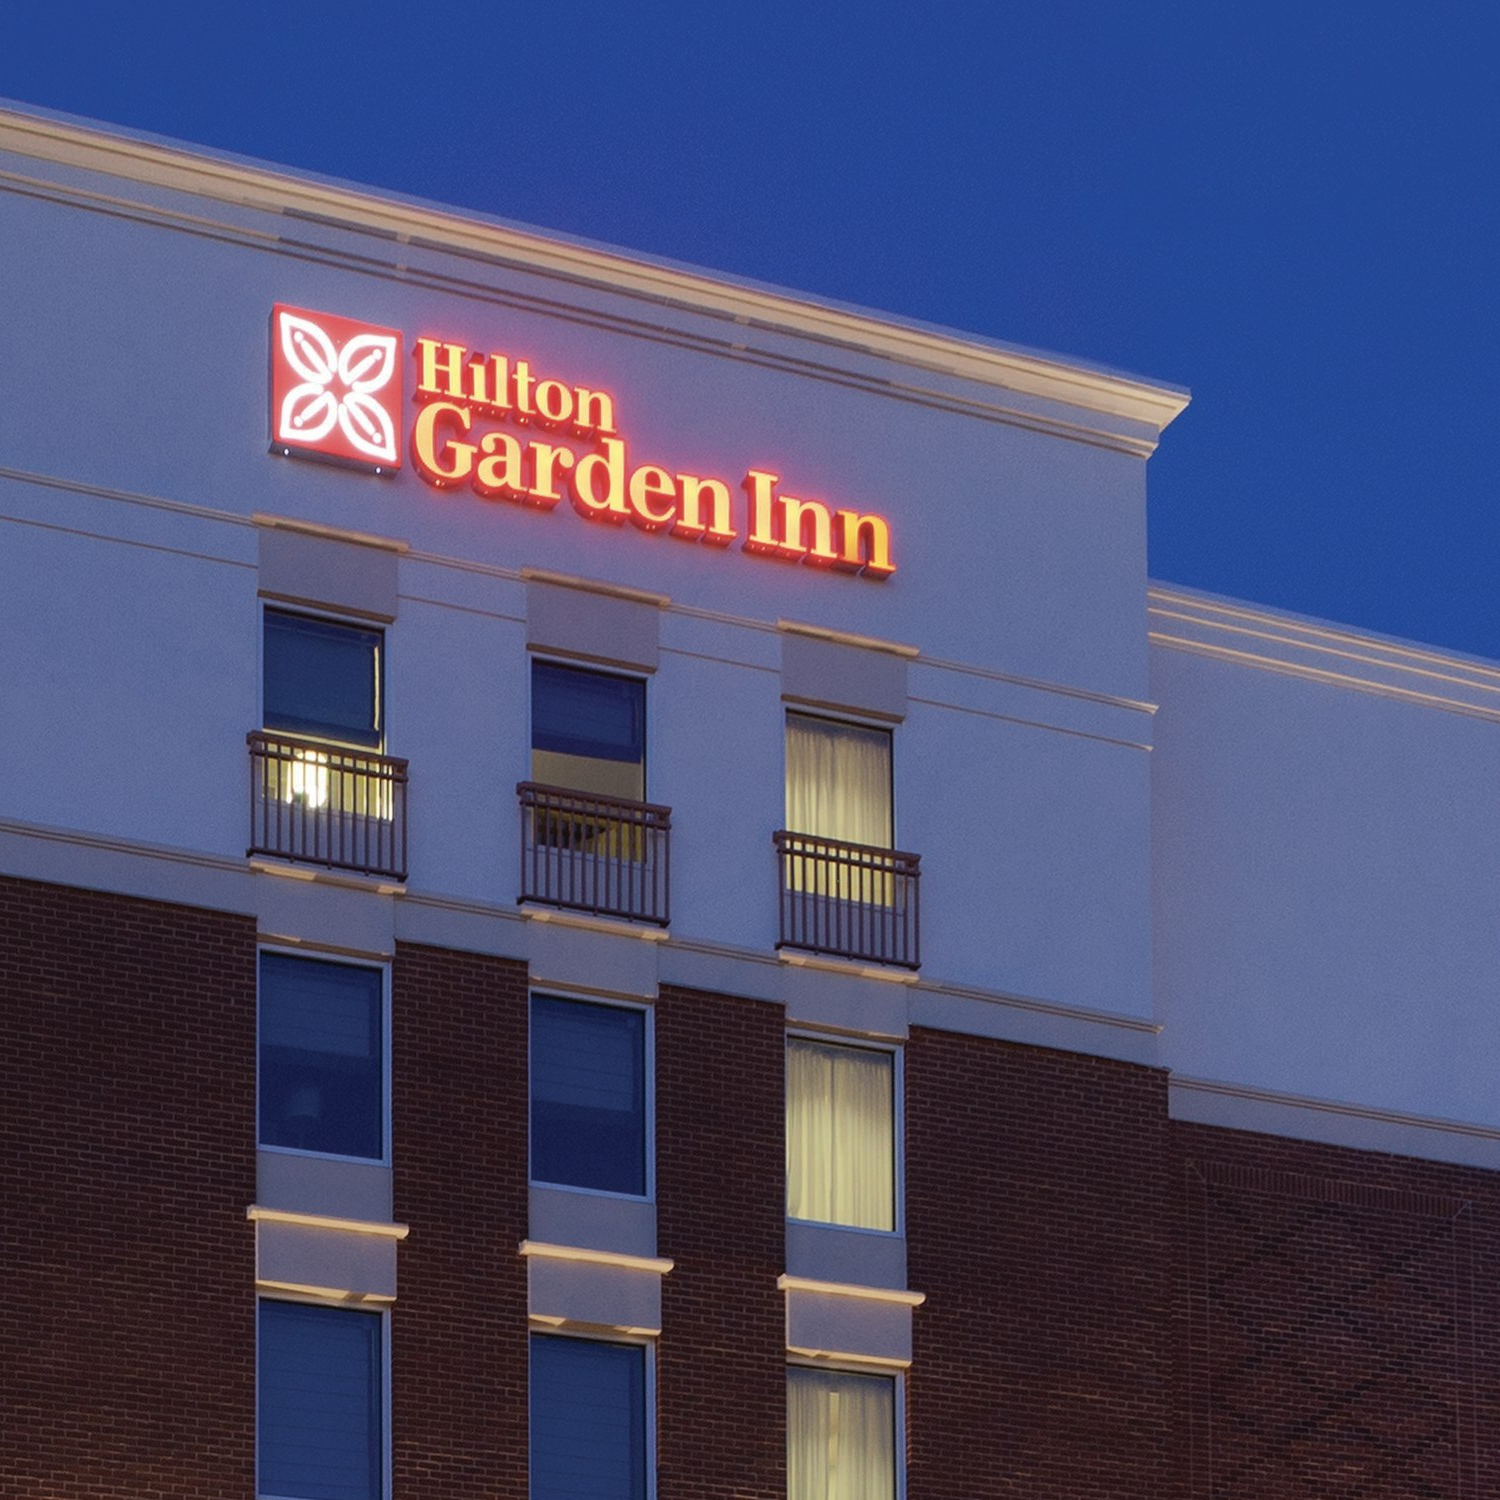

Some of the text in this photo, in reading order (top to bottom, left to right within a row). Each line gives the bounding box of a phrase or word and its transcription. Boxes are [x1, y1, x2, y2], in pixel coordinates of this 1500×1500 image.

[414, 337, 618, 437] Hilton
[411, 400, 897, 577] Garden Inn
